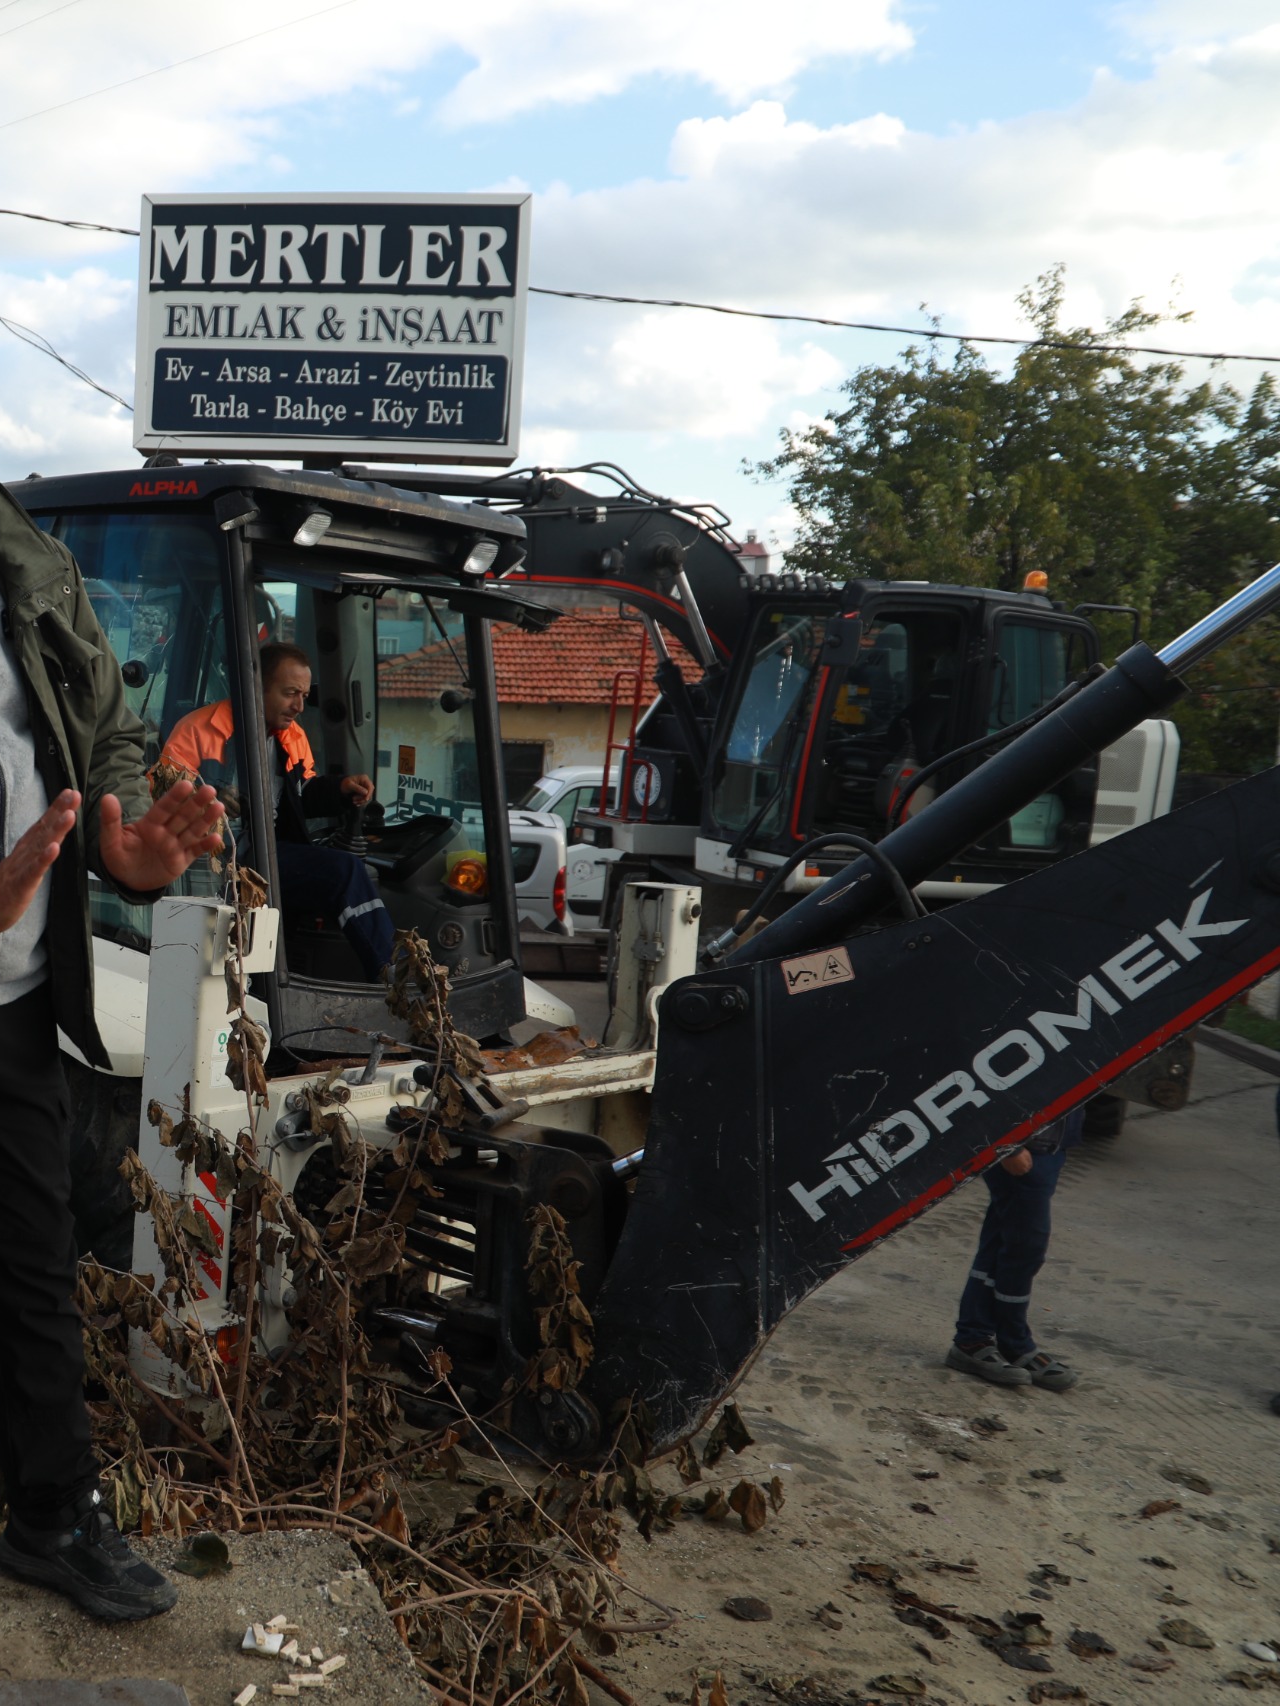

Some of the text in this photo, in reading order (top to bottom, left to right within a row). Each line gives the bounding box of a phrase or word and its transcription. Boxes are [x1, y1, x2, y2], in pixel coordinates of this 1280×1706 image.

[150, 223, 512, 288] MERTLER
[163, 303, 305, 341] EMLAK
[316, 305, 346, 342] &
[165, 357, 194, 382] Ev
[216, 358, 272, 384] Arsa
[296, 361, 361, 386] Arazi
[385, 362, 496, 393] Zeytinlik
[190, 394, 250, 419] Tarla
[274, 395, 347, 427] Bahçe
[371, 398, 419, 429] Köy
[426, 400, 464, 426] Evi
[128, 480, 199, 497] ALPHA
